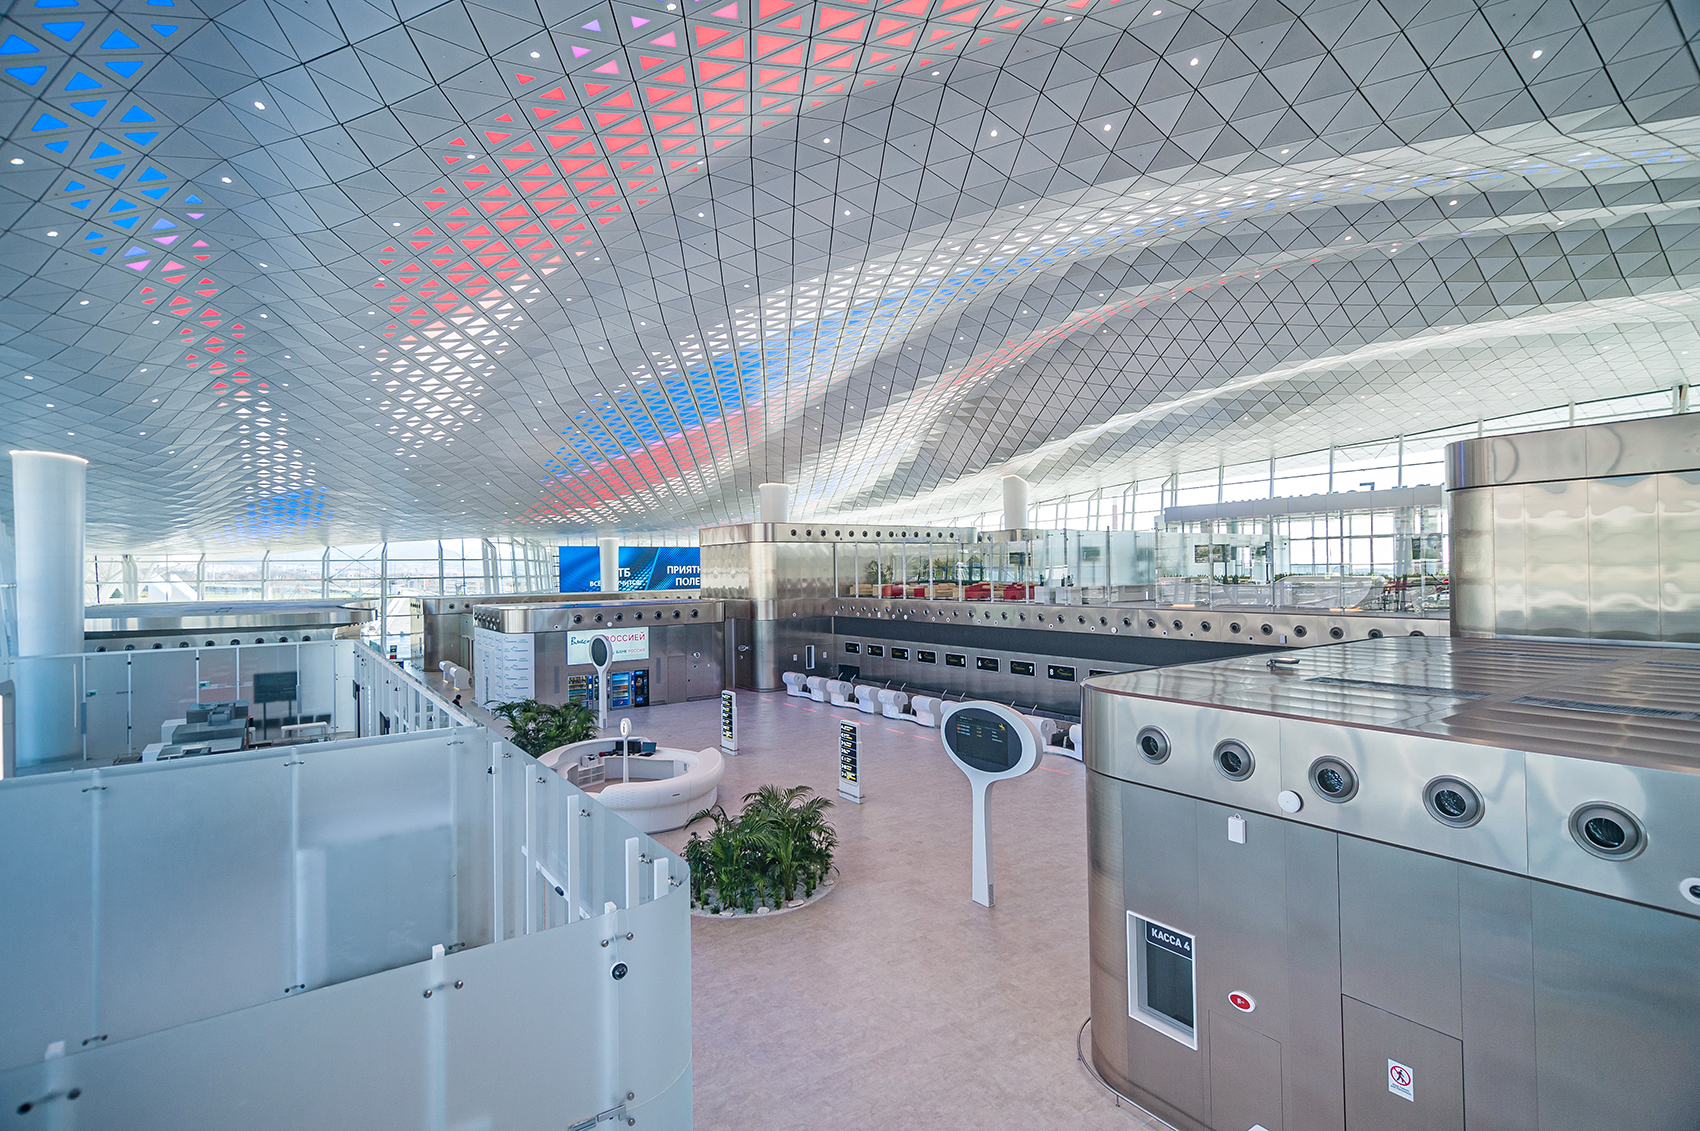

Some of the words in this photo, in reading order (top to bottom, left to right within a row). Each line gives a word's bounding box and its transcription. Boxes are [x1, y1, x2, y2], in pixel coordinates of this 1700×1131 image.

[618, 567, 631, 578] ТБ
[675, 577, 701, 586] ПОЛЕ
[1151, 927, 1182, 948] КАССА
[1183, 942, 1191, 951] 4
